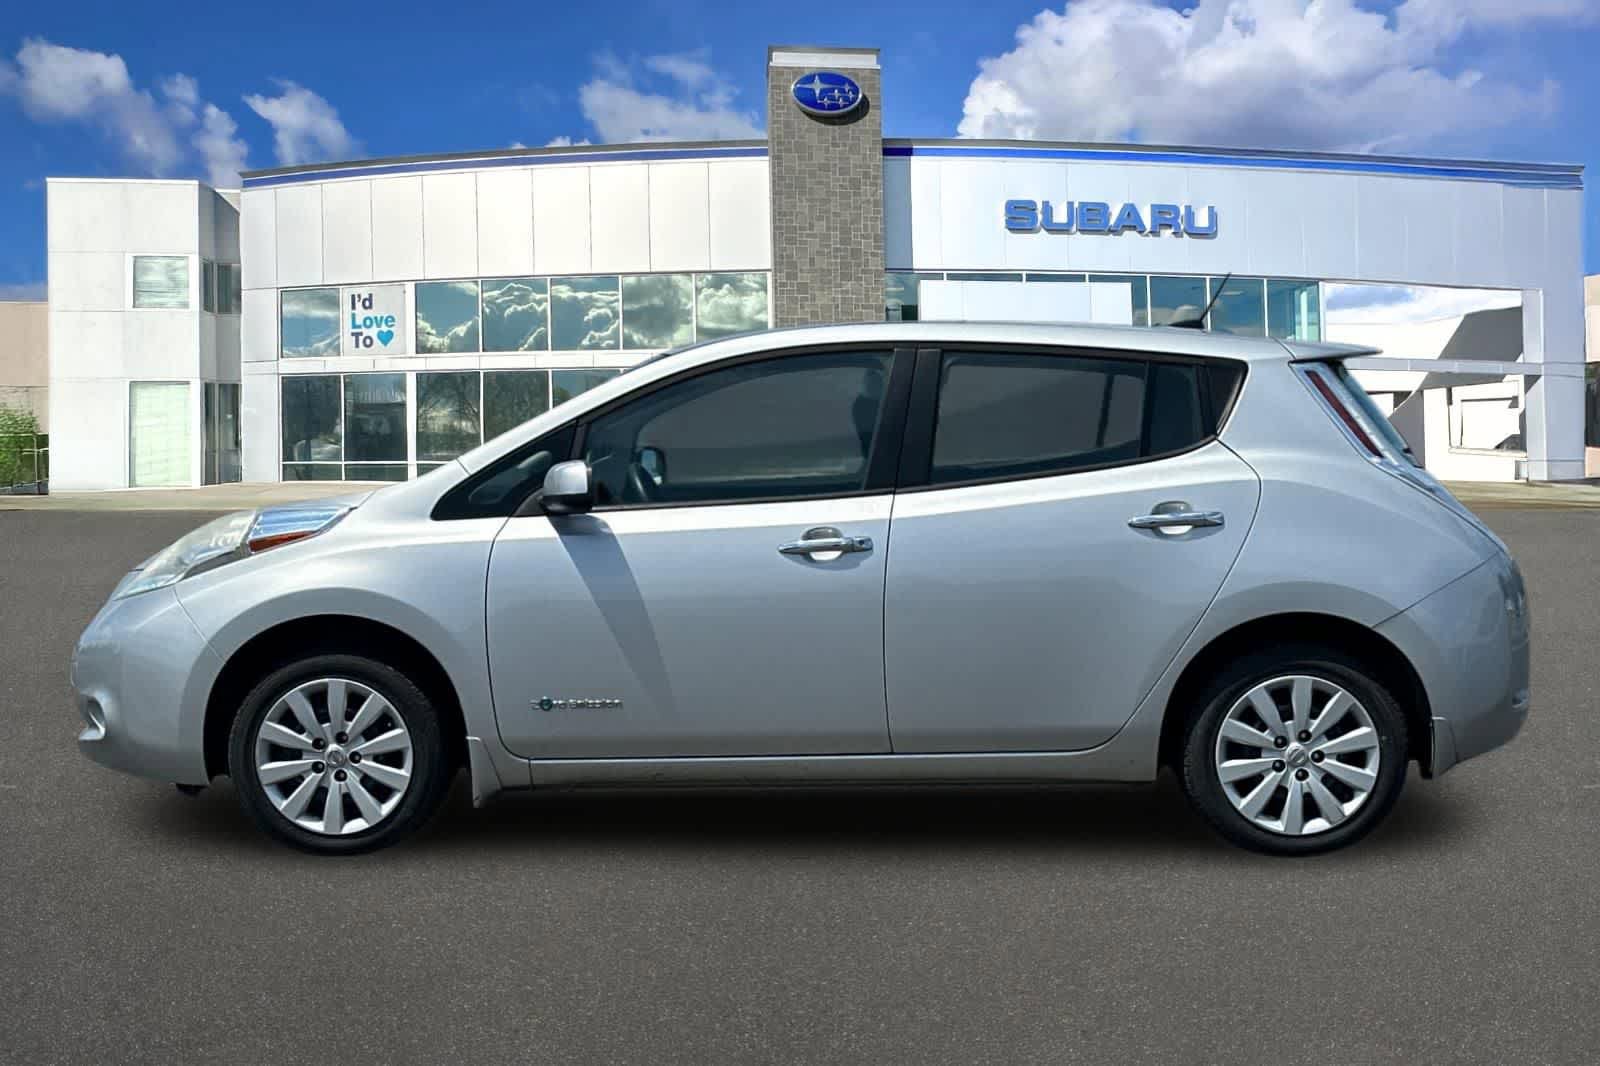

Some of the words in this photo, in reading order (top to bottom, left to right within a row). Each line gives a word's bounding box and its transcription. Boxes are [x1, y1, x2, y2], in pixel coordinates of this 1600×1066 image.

[1005, 199, 1218, 239] SUBARU
[351, 293, 373, 310] I'd
[351, 312, 396, 329] Love
[351, 331, 374, 349] To
